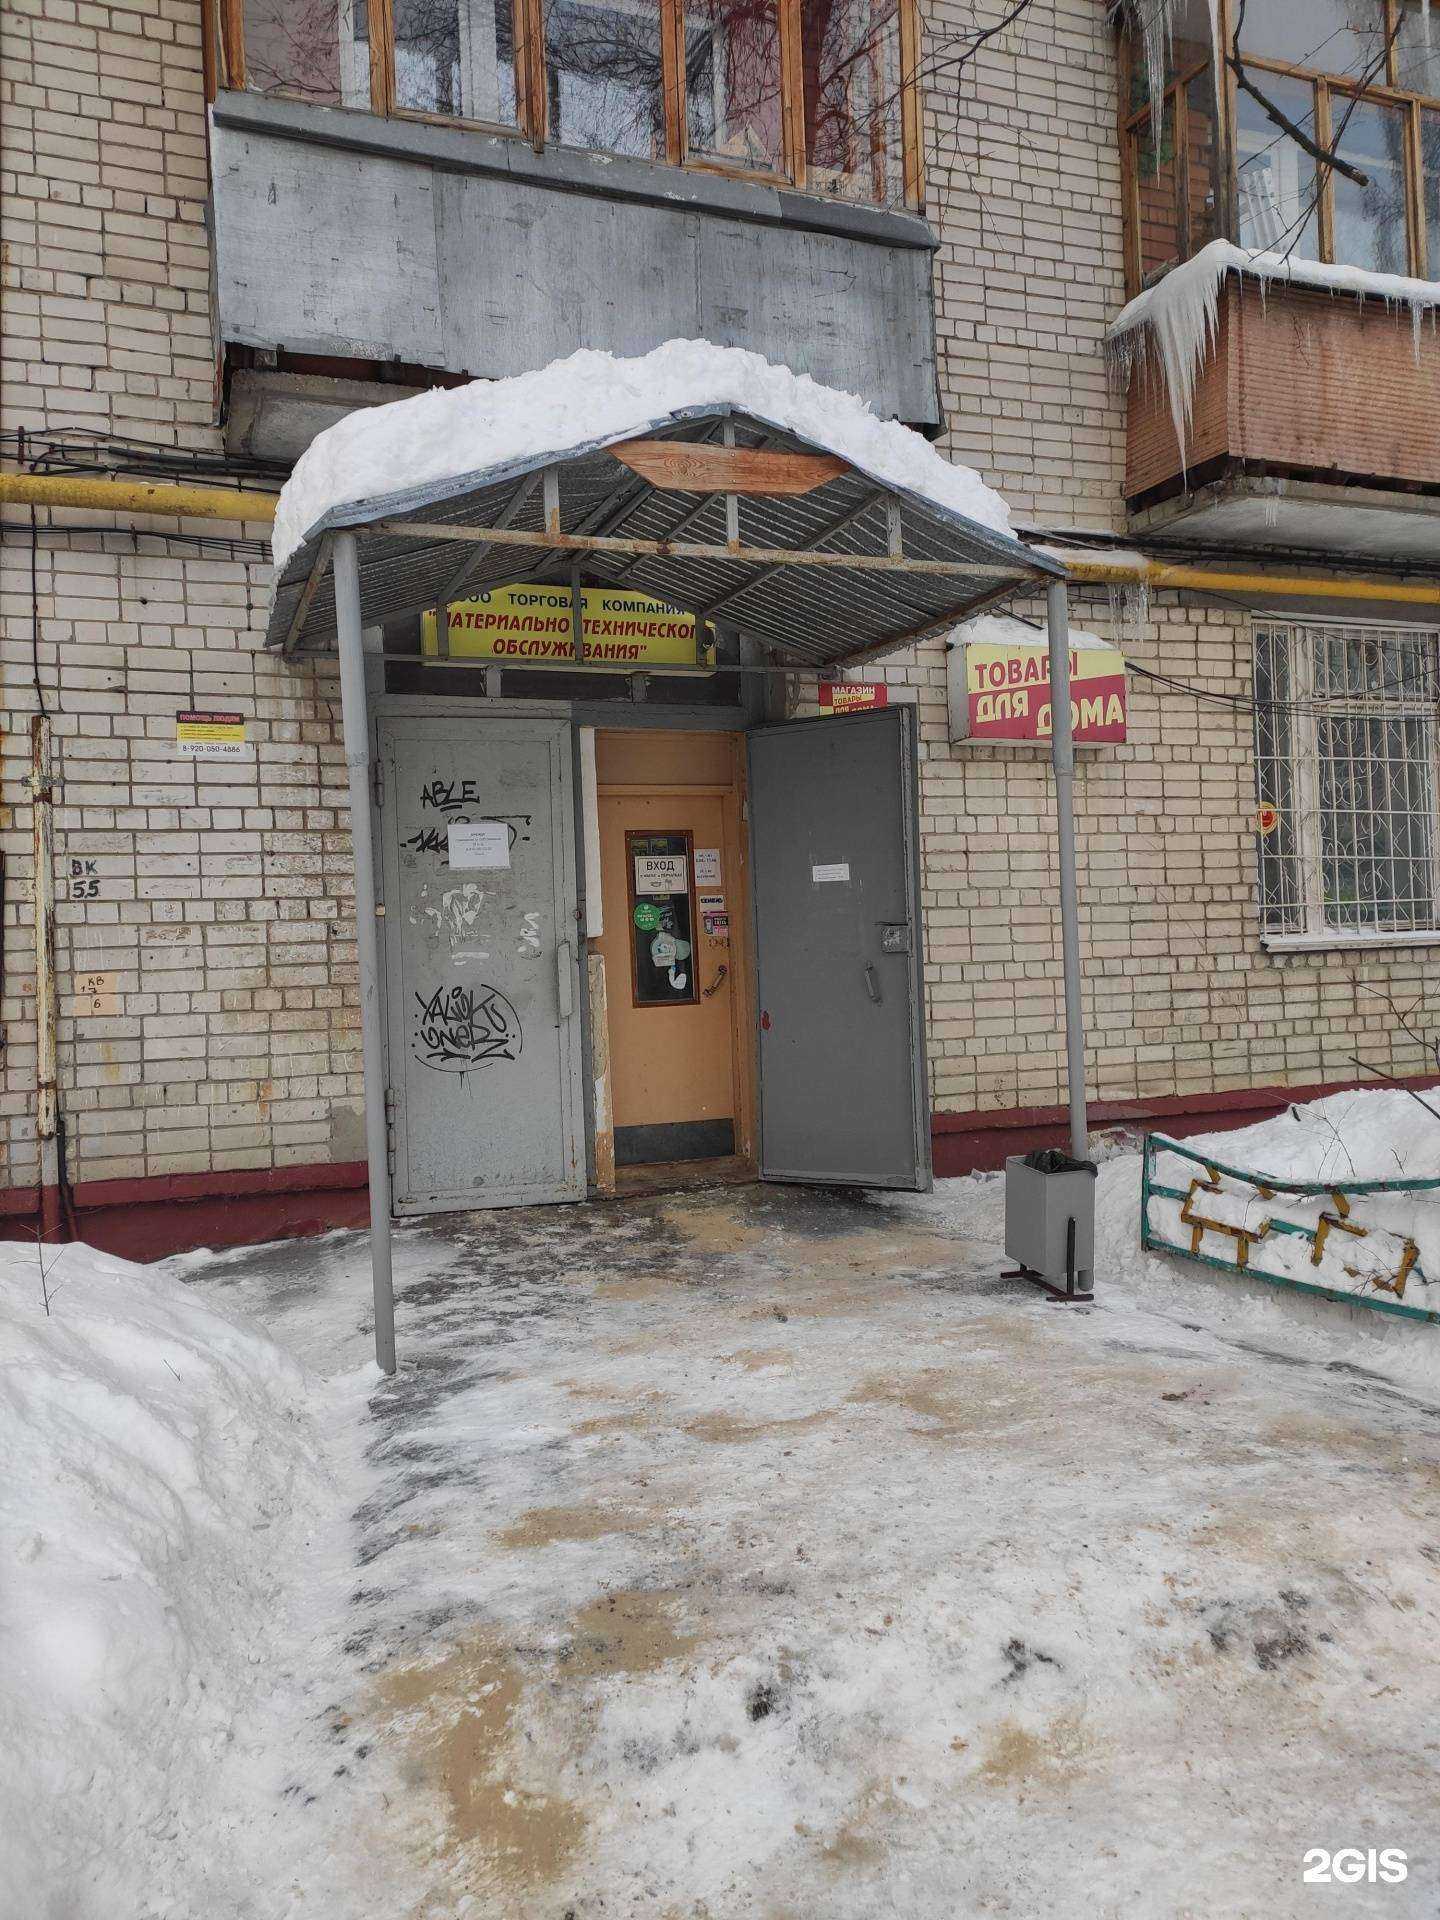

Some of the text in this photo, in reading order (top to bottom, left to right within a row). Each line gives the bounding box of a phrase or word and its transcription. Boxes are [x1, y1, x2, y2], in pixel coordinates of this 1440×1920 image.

[831, 686, 876, 694] МАГАЗИН
[834, 695, 863, 705] ТОВАРЫ
[975, 690, 1030, 723] ДЛЯ
[179, 713, 241, 724] ПОМОЩЬ ЛЮДЯМ
[646, 860, 675, 872] ВХОД
